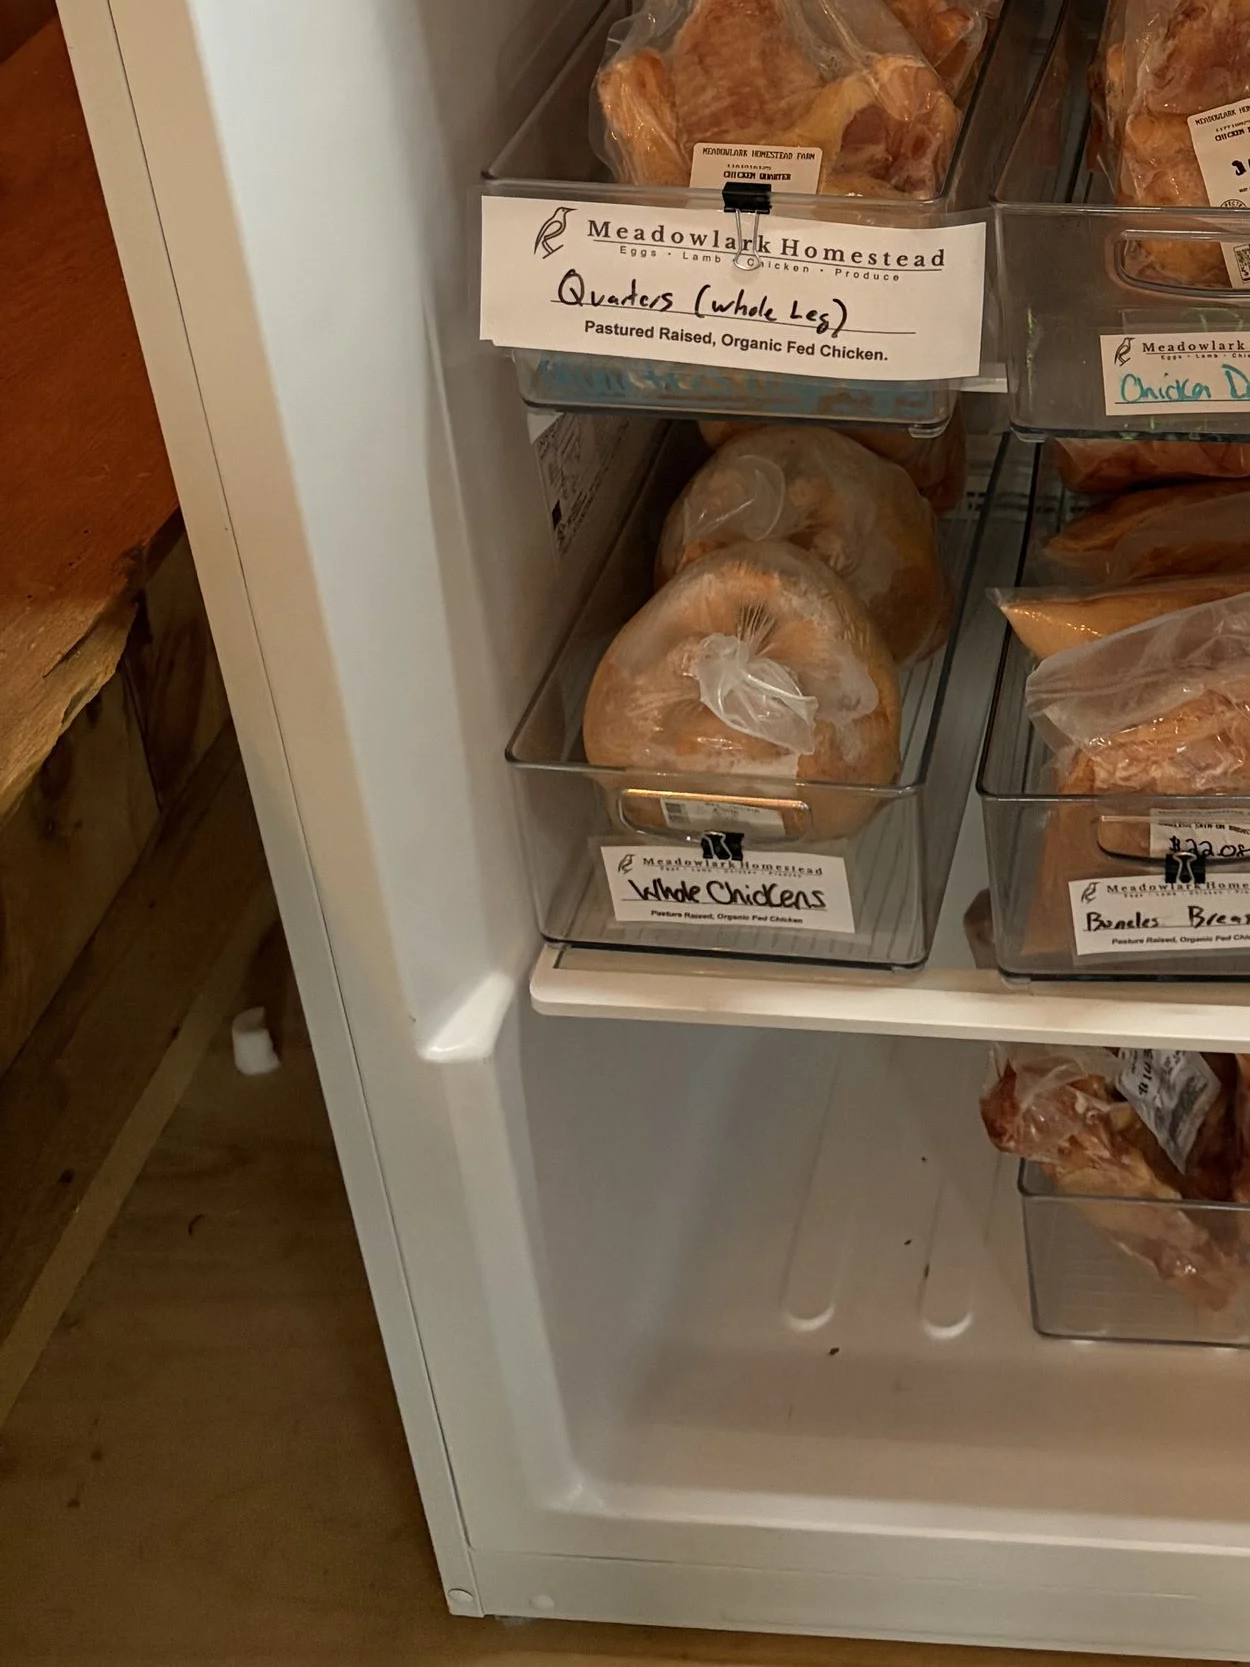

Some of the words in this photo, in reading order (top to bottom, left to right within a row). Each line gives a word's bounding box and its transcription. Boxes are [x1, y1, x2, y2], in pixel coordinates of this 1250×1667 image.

[1214, 127, 1246, 142] CHICKEN
[751, 150, 794, 160] HOMESTEAD
[723, 170, 757, 180] CHICKEN
[587, 218, 773, 255] Meadowlark
[779, 238, 946, 268] Homestead
[619, 245, 660, 260] Eggs
[682, 250, 722, 264] Lamb
[834, 267, 901, 283] Produce
[694, 282, 778, 322] (whole
[789, 297, 849, 340] Leg)
[584, 319, 655, 339] Pastured
[658, 324, 717, 348] Raised,
[720, 333, 783, 354] Organic
[786, 340, 816, 357] Fed
[819, 342, 889, 362] Chicken.
[1142, 340, 1246, 353] Meadowlark
[642, 857, 740, 870] Meadowlark
[740, 860, 823, 876] Homestead
[628, 878, 701, 903] Whole
[706, 880, 828, 910] Chickens
[1107, 882, 1201, 894] Meadowlark
[752, 915, 768, 923] Fed
[1180, 935, 1213, 944] Organic
[1215, 934, 1232, 942] Fed
